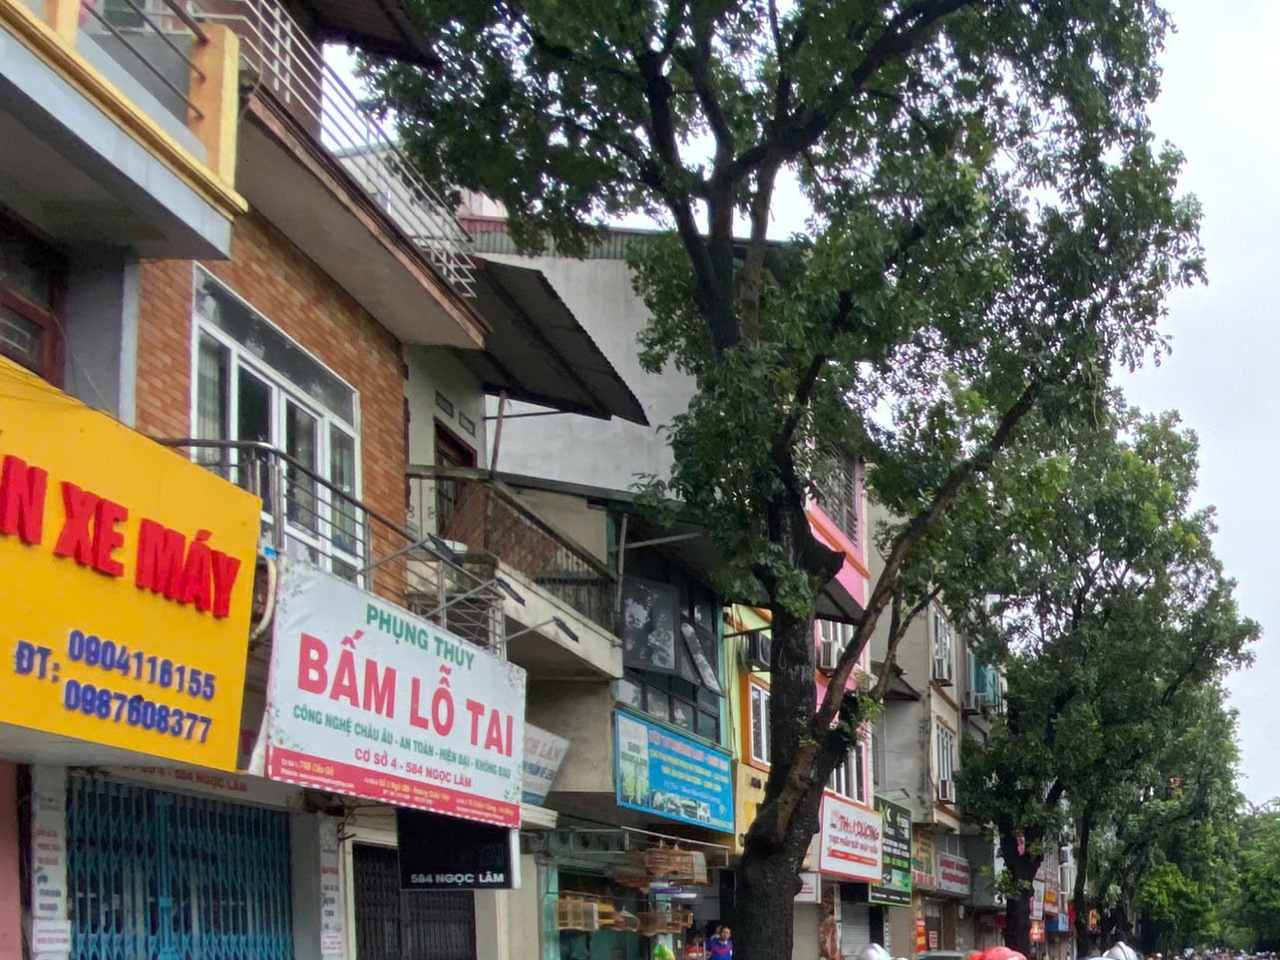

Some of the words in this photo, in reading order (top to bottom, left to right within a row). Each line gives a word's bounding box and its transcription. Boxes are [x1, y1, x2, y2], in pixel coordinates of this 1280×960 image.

[0, 454, 48, 546] N
[54, 481, 129, 578] XE
[136, 517, 241, 619] MÁY
[366, 603, 429, 651] PHỤNG
[297, 629, 397, 719] BẤM
[409, 664, 455, 737] LỖ
[466, 698, 514, 758] TAI
[293, 703, 323, 725] CÔNG
[354, 720, 379, 741] CHÂU
[400, 736, 411, 750] AN
[355, 747, 371, 762] CƠ
[373, 750, 388, 767] SỞ
[390, 757, 397, 769] 4
[405, 762, 423, 775] 584
[426, 767, 452, 784] NGỌC
[453, 773, 472, 787] LÂM
[411, 873, 433, 884] 584
[435, 873, 475, 886] NGỌC
[478, 871, 505, 883] LÂM
